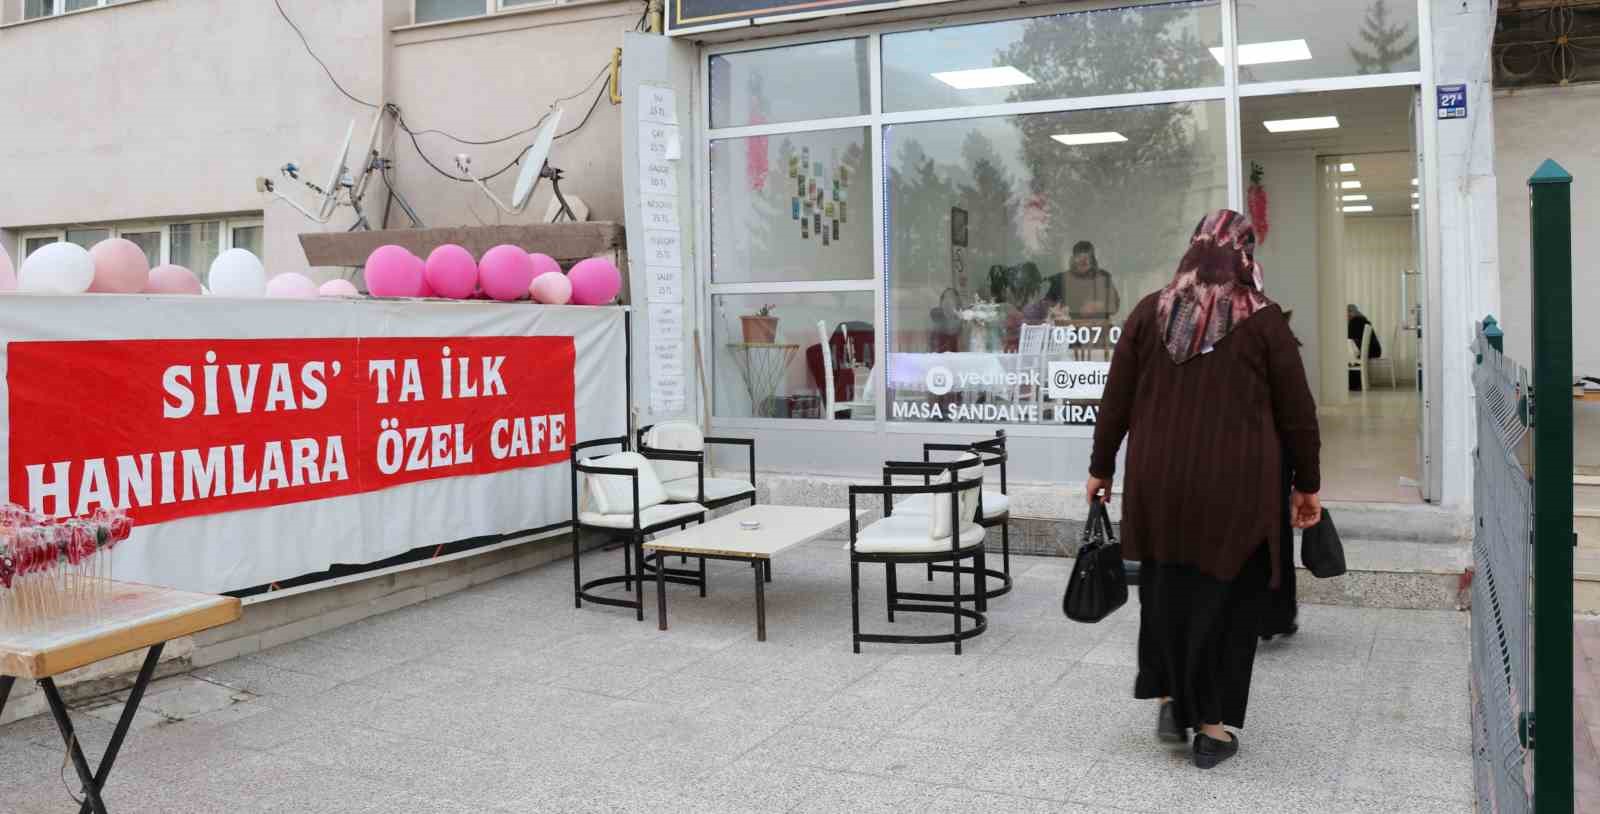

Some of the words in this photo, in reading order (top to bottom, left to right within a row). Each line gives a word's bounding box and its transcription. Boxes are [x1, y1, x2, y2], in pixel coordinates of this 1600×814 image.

[1441, 95, 1457, 107] 27
[1109, 326, 1122, 344] 0
[162, 350, 342, 419] SİVAS'
[369, 359, 425, 404] TA
[441, 346, 507, 399] İLK
[958, 369, 1041, 388] yedirenk
[1054, 369, 1109, 389] @yedir
[892, 402, 943, 419] MASA
[947, 402, 1039, 422] SANDALYE
[1053, 401, 1099, 423] KİRA
[26, 435, 348, 520] HANIMLARA
[376, 418, 473, 475] ÖZEL
[490, 413, 567, 459] CAFE
